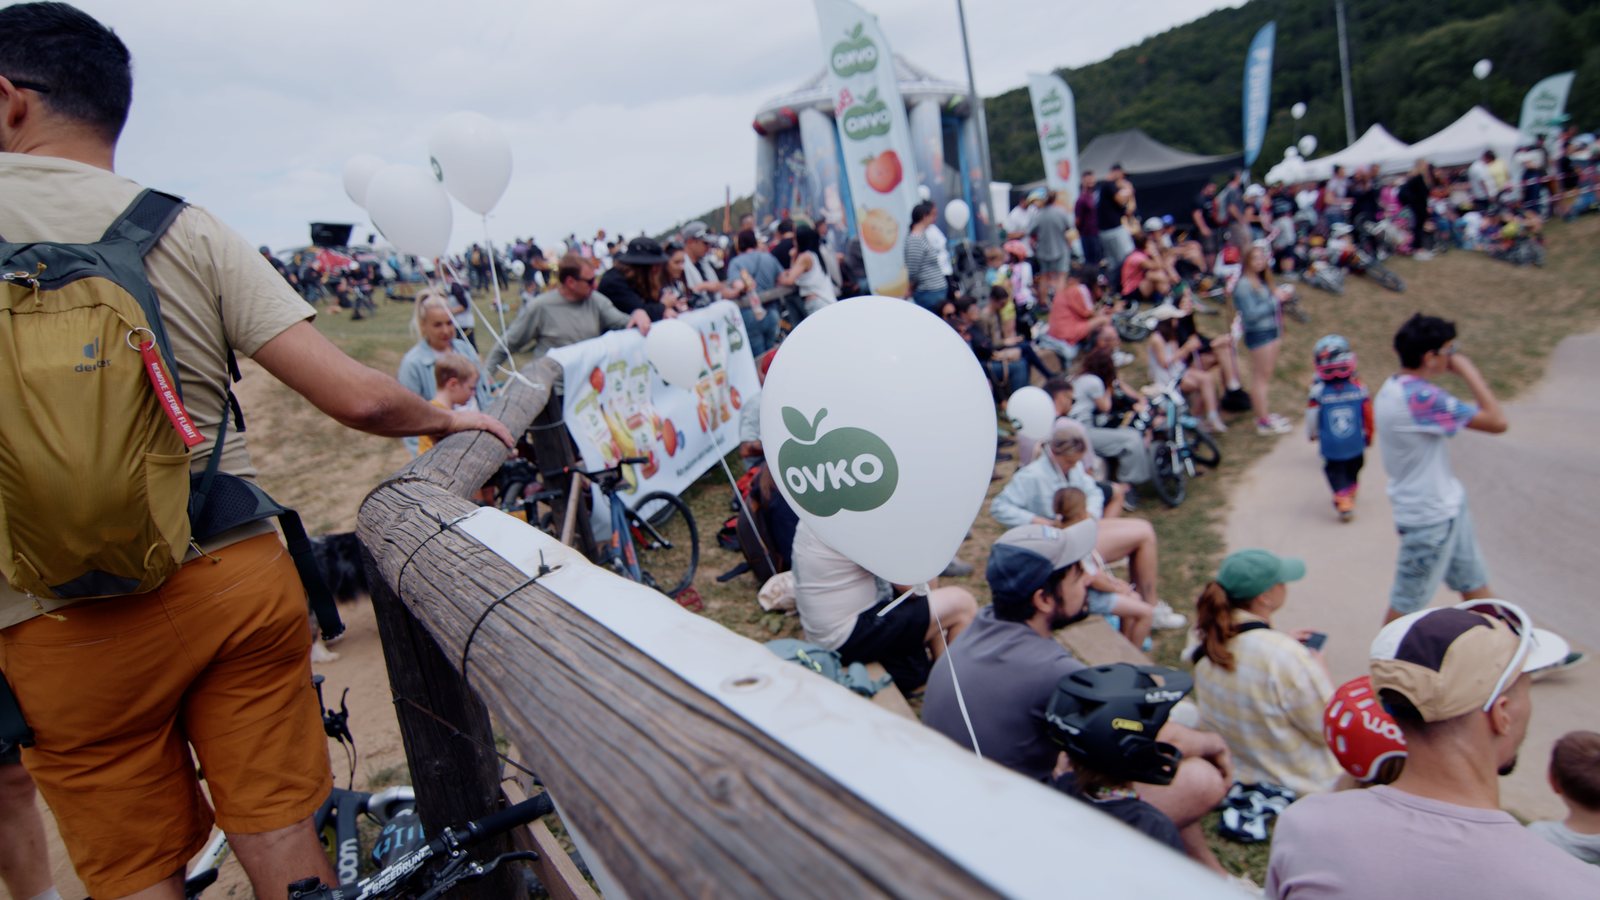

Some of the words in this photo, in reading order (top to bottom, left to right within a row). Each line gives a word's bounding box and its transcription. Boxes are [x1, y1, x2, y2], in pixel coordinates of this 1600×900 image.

[151, 362, 169, 391] REMOVE
[163, 390, 183, 418] BEFORE
[177, 416, 197, 439] FLIGHT
[785, 453, 884, 494] OVKO
